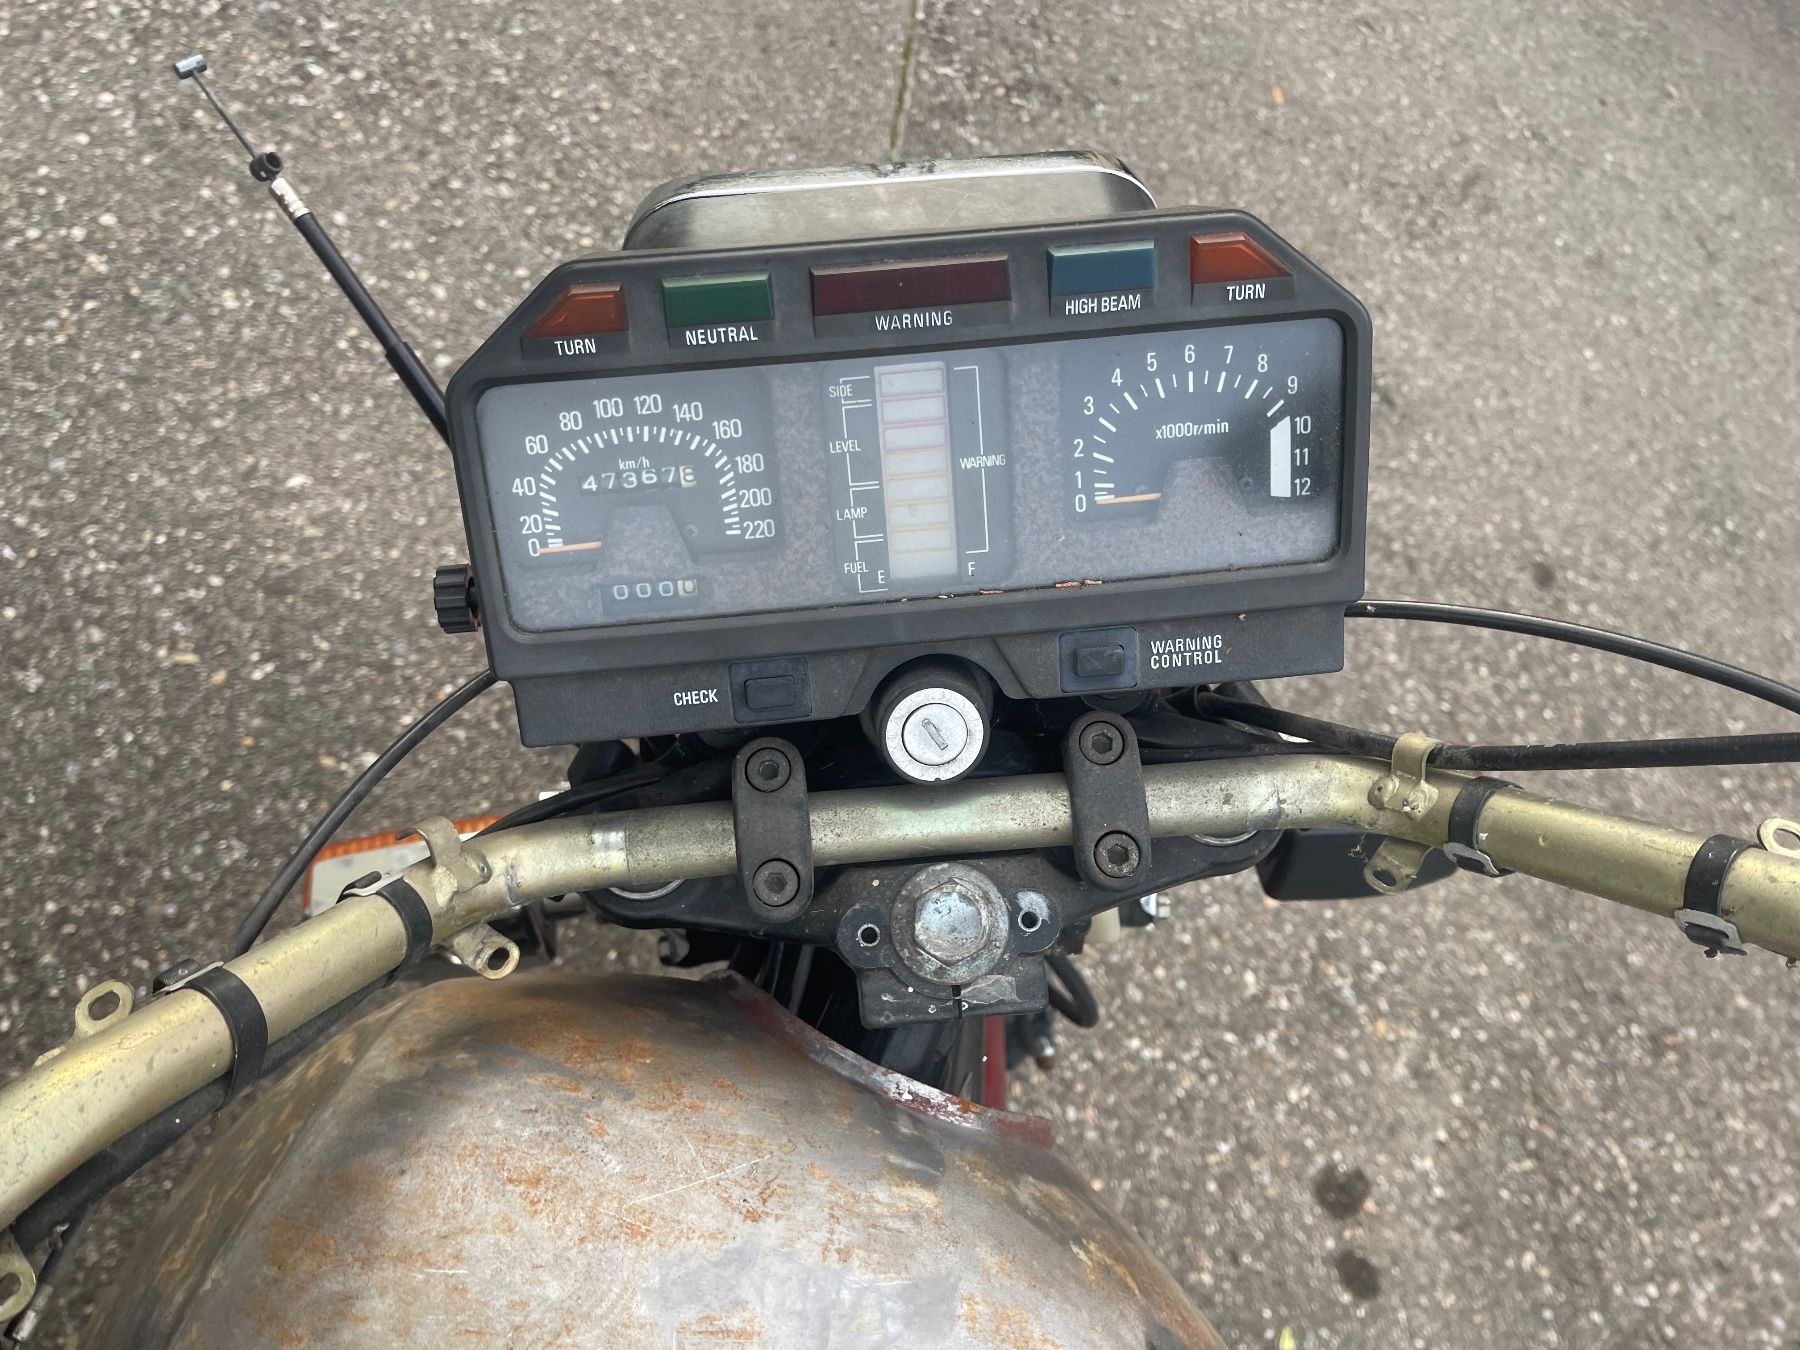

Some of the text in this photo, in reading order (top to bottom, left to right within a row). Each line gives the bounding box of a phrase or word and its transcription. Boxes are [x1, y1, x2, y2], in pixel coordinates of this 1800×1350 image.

[1227, 283, 1266, 301] TURN
[1065, 294, 1141, 316] HIGH BEAM
[875, 310, 953, 331] WARNING
[685, 326, 759, 346] NEUTRAL
[554, 338, 597, 356] TURN
[1184, 344, 1195, 363] 6
[1224, 345, 1234, 364] 7
[1147, 352, 1157, 371] 5
[1257, 354, 1268, 372] 8
[1111, 368, 1123, 387] 4
[1287, 376, 1298, 394] 9
[829, 384, 853, 398] SIDE
[593, 397, 624, 419] 100
[633, 394, 662, 415] 120
[672, 402, 703, 422] 140
[1084, 396, 1094, 415] 3
[559, 410, 582, 431] 80
[712, 418, 742, 440] 160
[1295, 416, 1311, 435] 10
[525, 434, 548, 454] 60
[829, 439, 861, 453] LEVEL
[1073, 439, 1084, 457] 2
[618, 456, 650, 471] km/h
[734, 453, 764, 474] 180
[960, 454, 1006, 469] WARNING
[1295, 448, 1309, 466] 11
[512, 476, 536, 496] 40
[1075, 471, 1082, 489] 1
[1295, 477, 1311, 496] 12
[739, 488, 772, 508] 200
[1075, 494, 1086, 512] 0
[837, 506, 867, 521] LAMP
[520, 514, 542, 534] 20
[744, 519, 775, 540] 220
[528, 538, 541, 557] 0
[844, 561, 868, 574] FUEL
[878, 570, 885, 584] E
[968, 562, 976, 575] F
[1150, 634, 1224, 656] WARNING
[1150, 648, 1223, 669] CONTROL
[672, 688, 719, 706] CHECK
